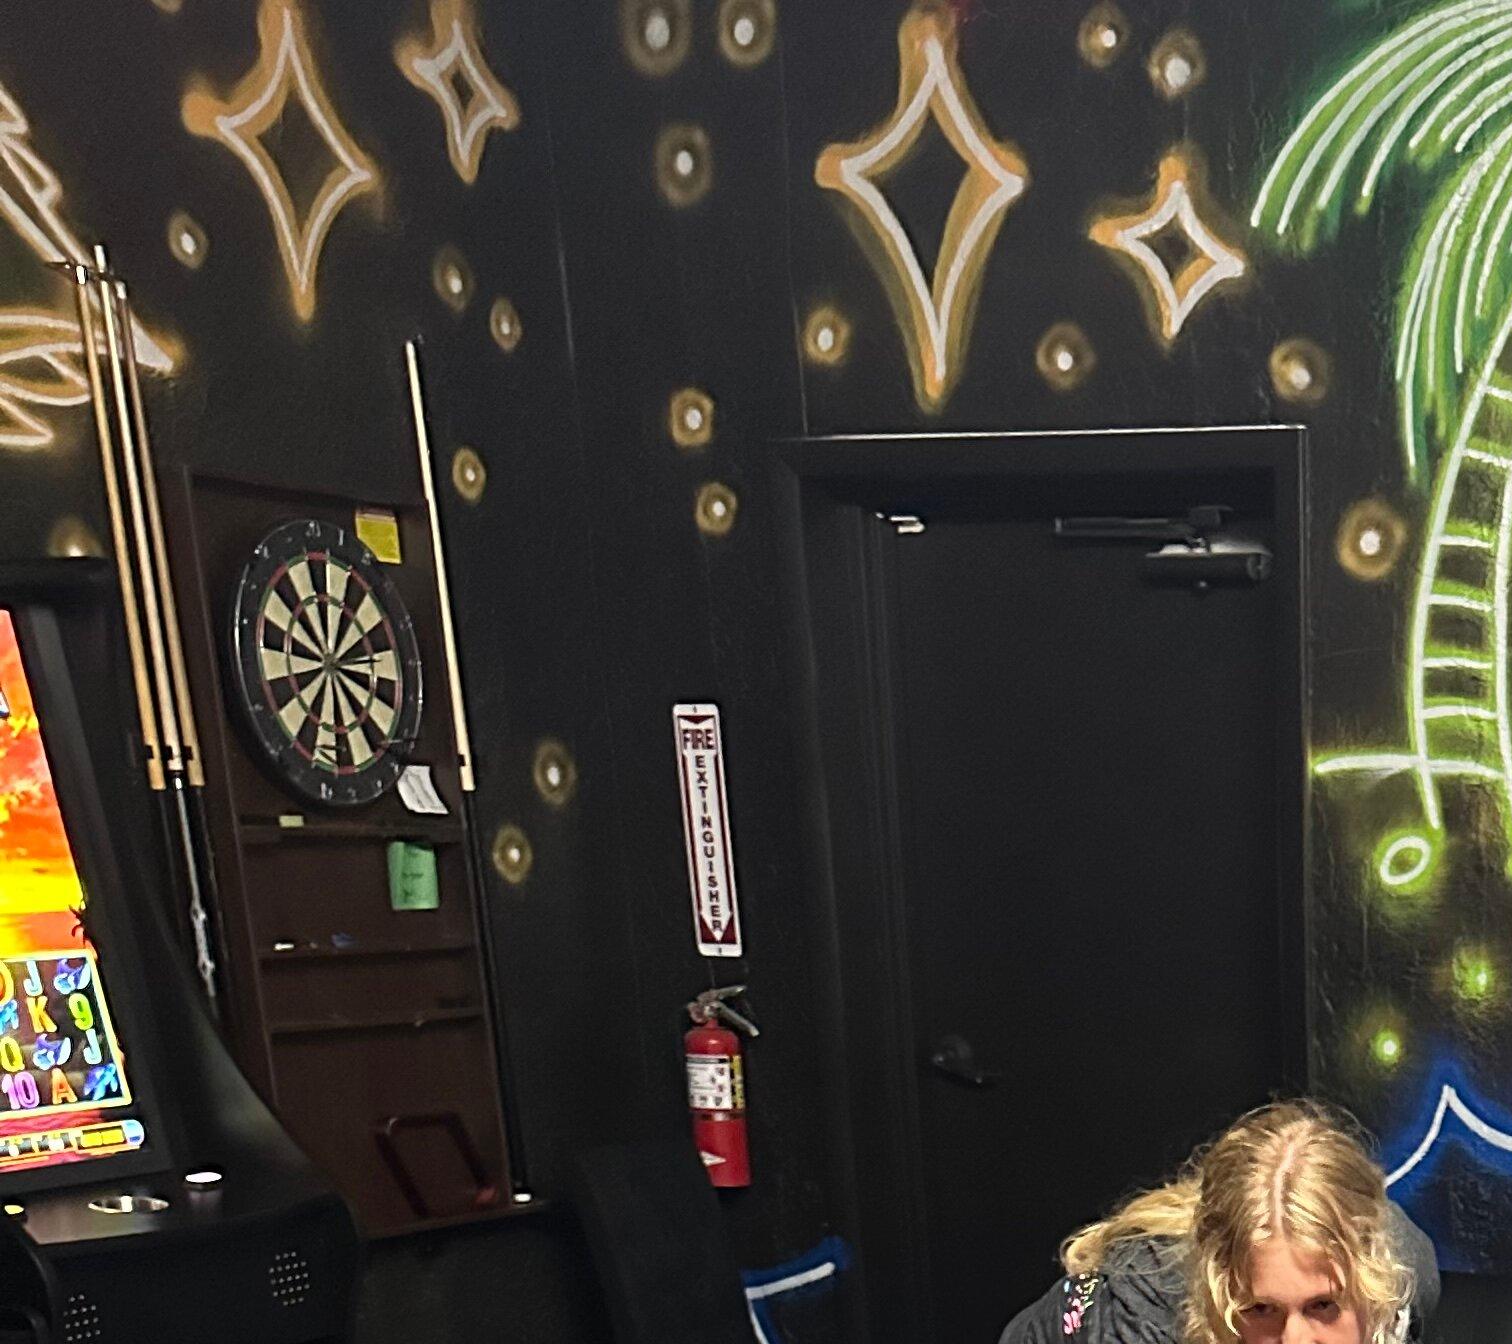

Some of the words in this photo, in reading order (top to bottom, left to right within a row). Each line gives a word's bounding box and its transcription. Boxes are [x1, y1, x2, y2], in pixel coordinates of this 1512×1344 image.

[682, 728, 715, 750] FIRE
[694, 755, 723, 932] EXTINGUISHER
[27, 995, 58, 1033] K
[68, 992, 94, 1031] 9
[1, 1071, 40, 1110] 10
[51, 1067, 78, 1105] A
